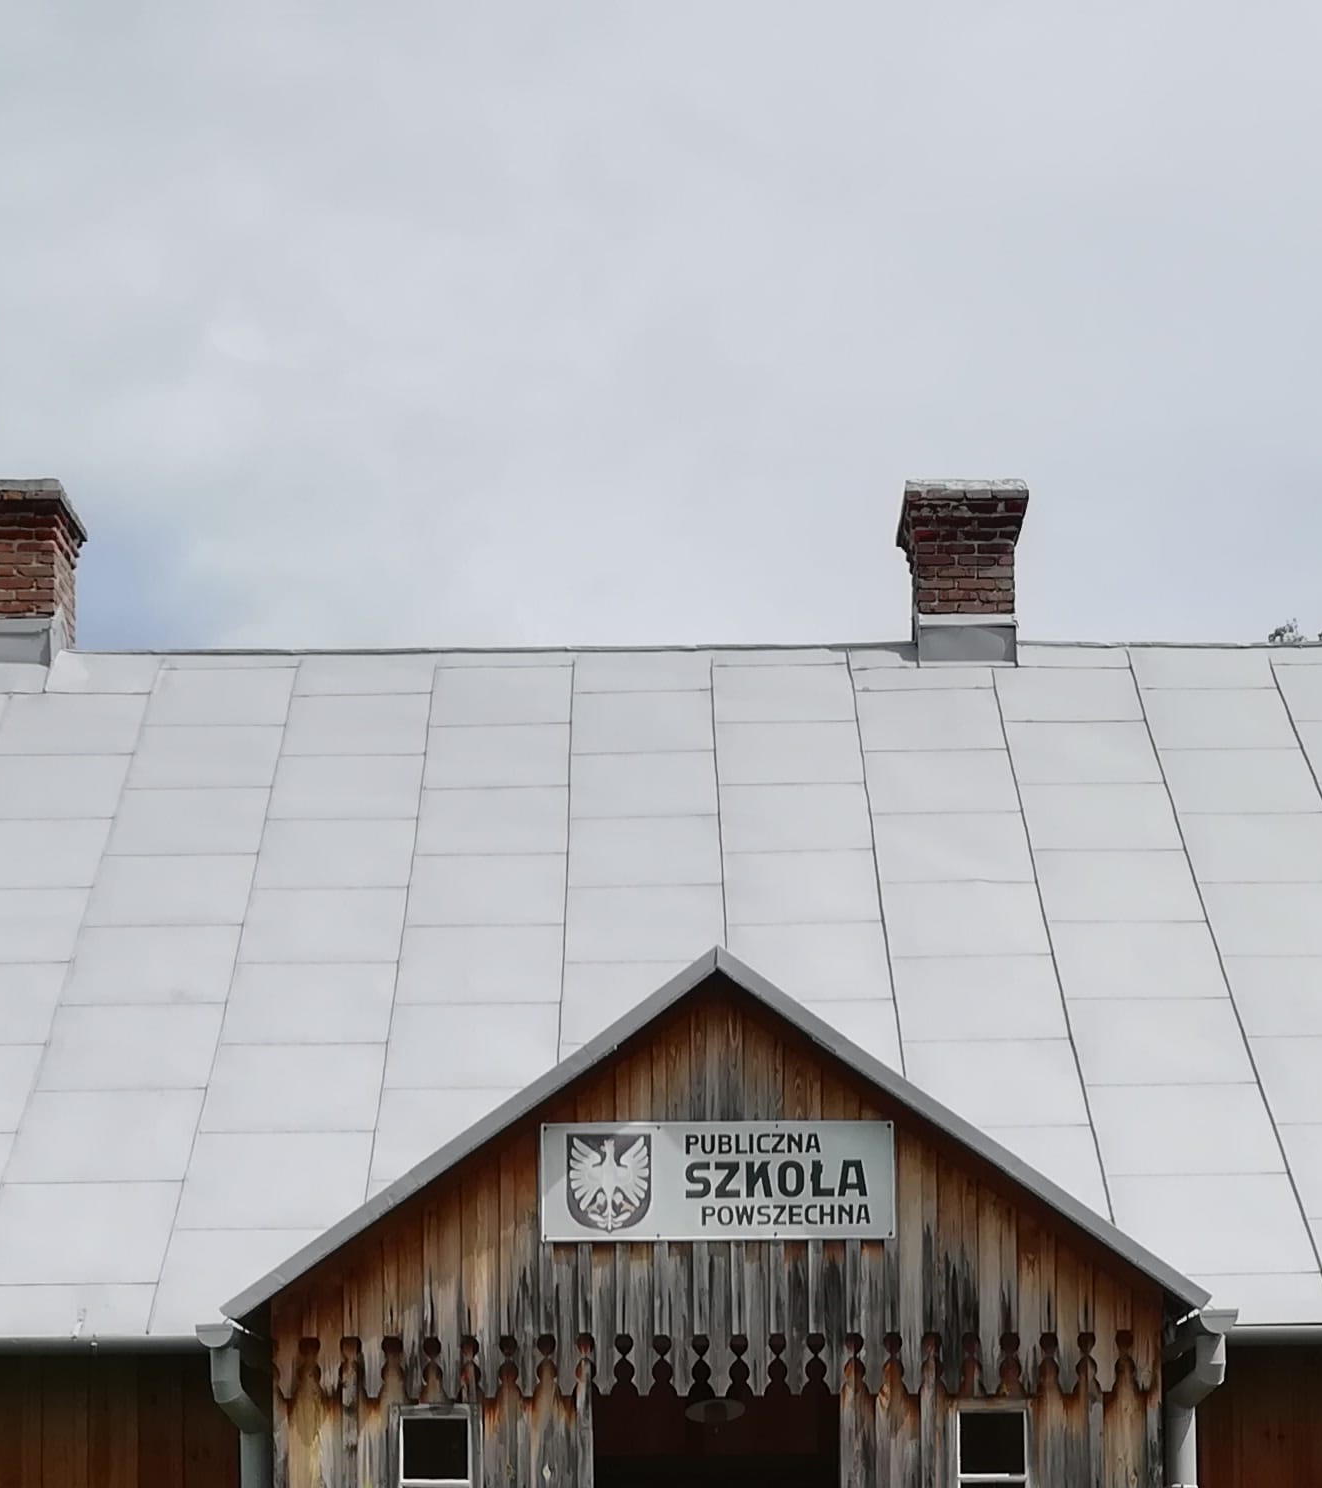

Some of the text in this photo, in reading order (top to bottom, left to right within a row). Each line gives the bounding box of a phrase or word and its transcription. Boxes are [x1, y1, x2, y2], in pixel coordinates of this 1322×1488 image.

[685, 1133, 821, 1155] PUBLICZNA
[685, 1159, 868, 1199] SZKOŁA
[701, 1203, 871, 1226] POWSZECHNA
